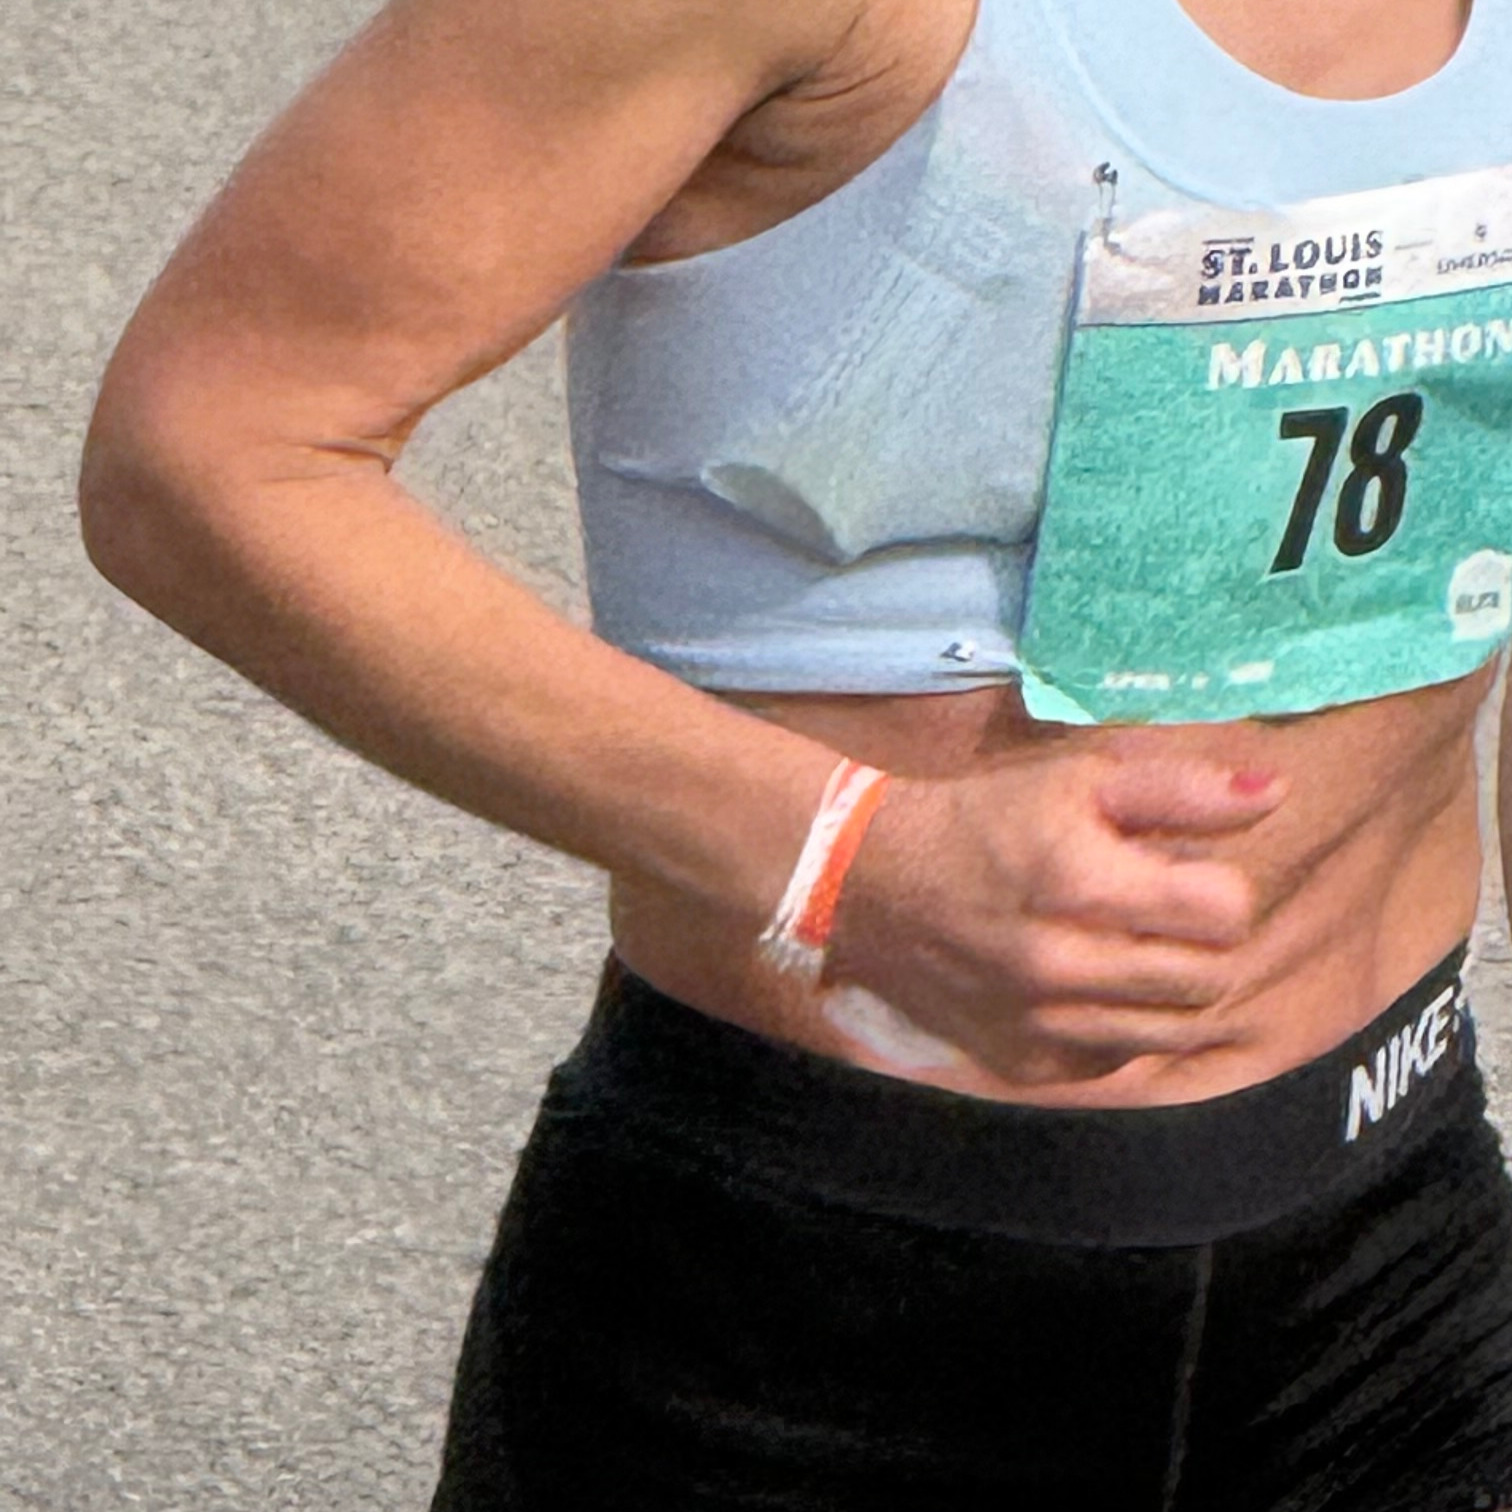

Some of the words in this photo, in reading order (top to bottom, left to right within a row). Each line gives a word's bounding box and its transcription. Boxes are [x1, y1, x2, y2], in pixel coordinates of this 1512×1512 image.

[1201, 247, 1259, 280] ST.
[1268, 230, 1383, 274] LOUIS
[1269, 392, 1424, 575] 78
[1345, 985, 1454, 1142] NIKE
